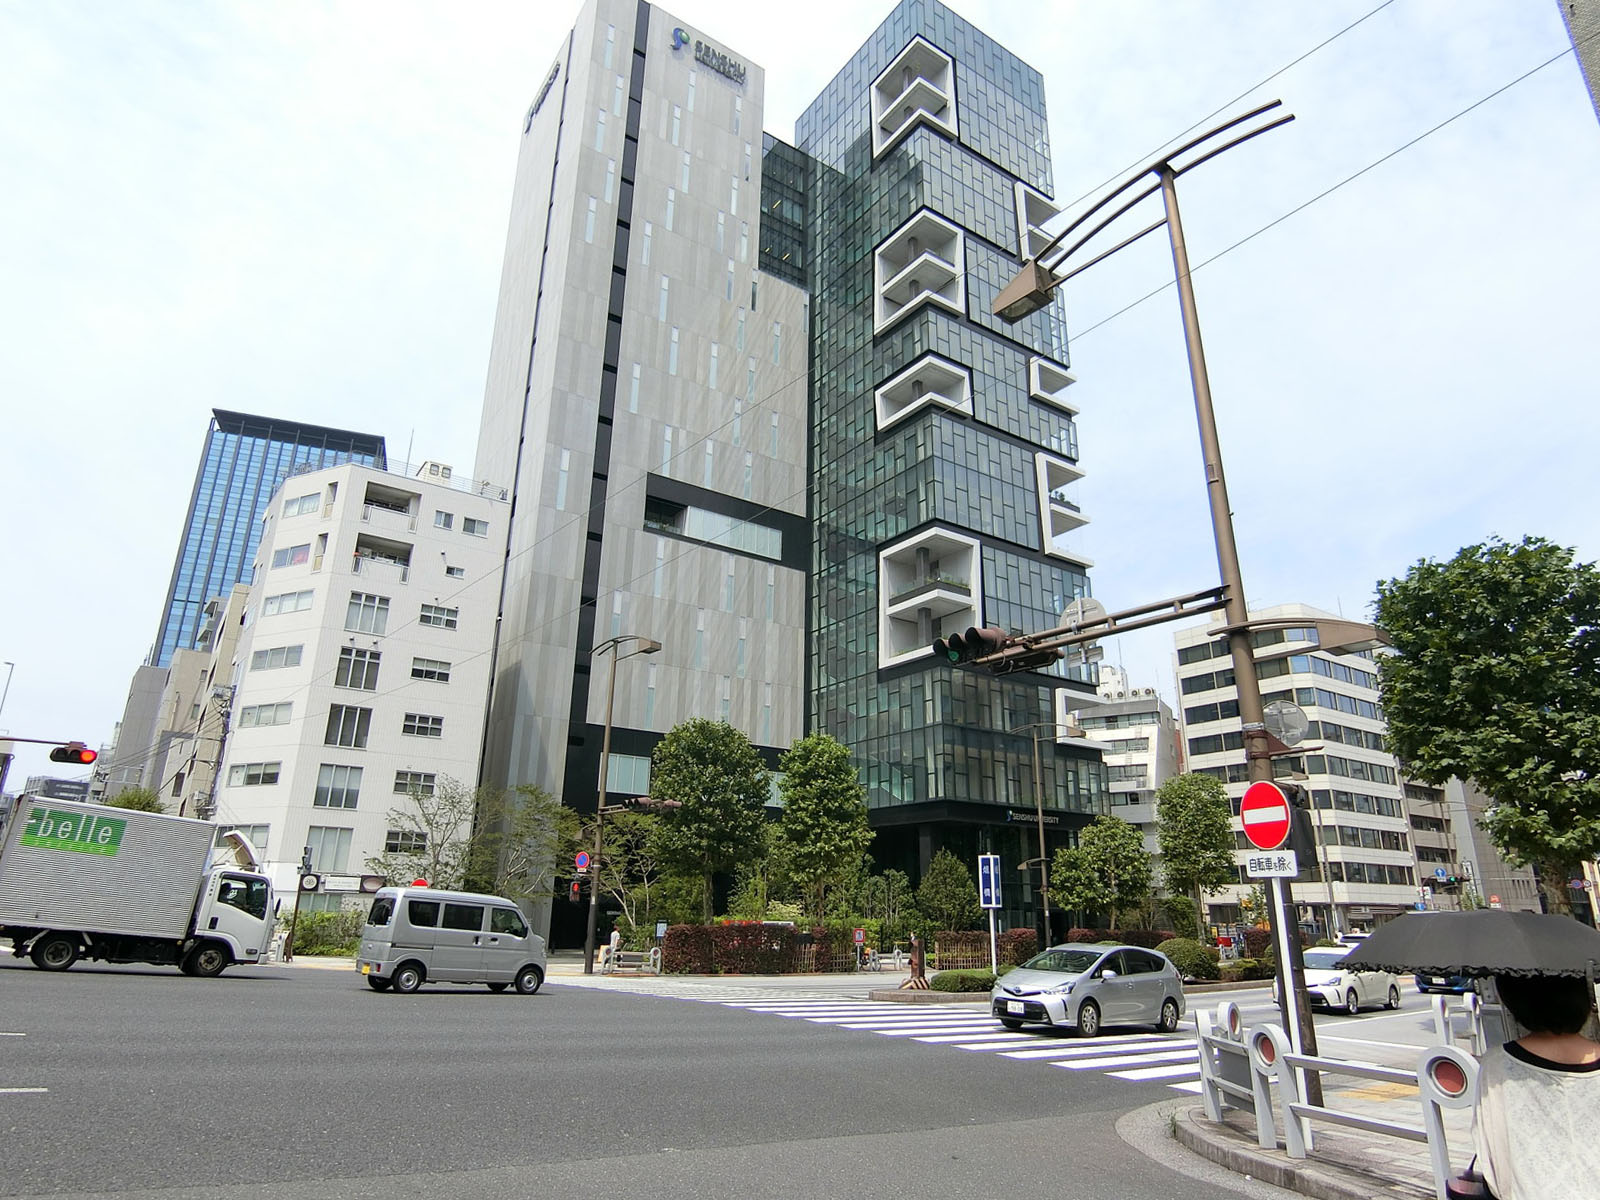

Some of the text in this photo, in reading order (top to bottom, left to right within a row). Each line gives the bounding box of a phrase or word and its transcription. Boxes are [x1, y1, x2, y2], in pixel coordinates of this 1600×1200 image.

[695, 40, 746, 77] SENSHU
[1249, 856, 1292, 871] 自転車を除く
